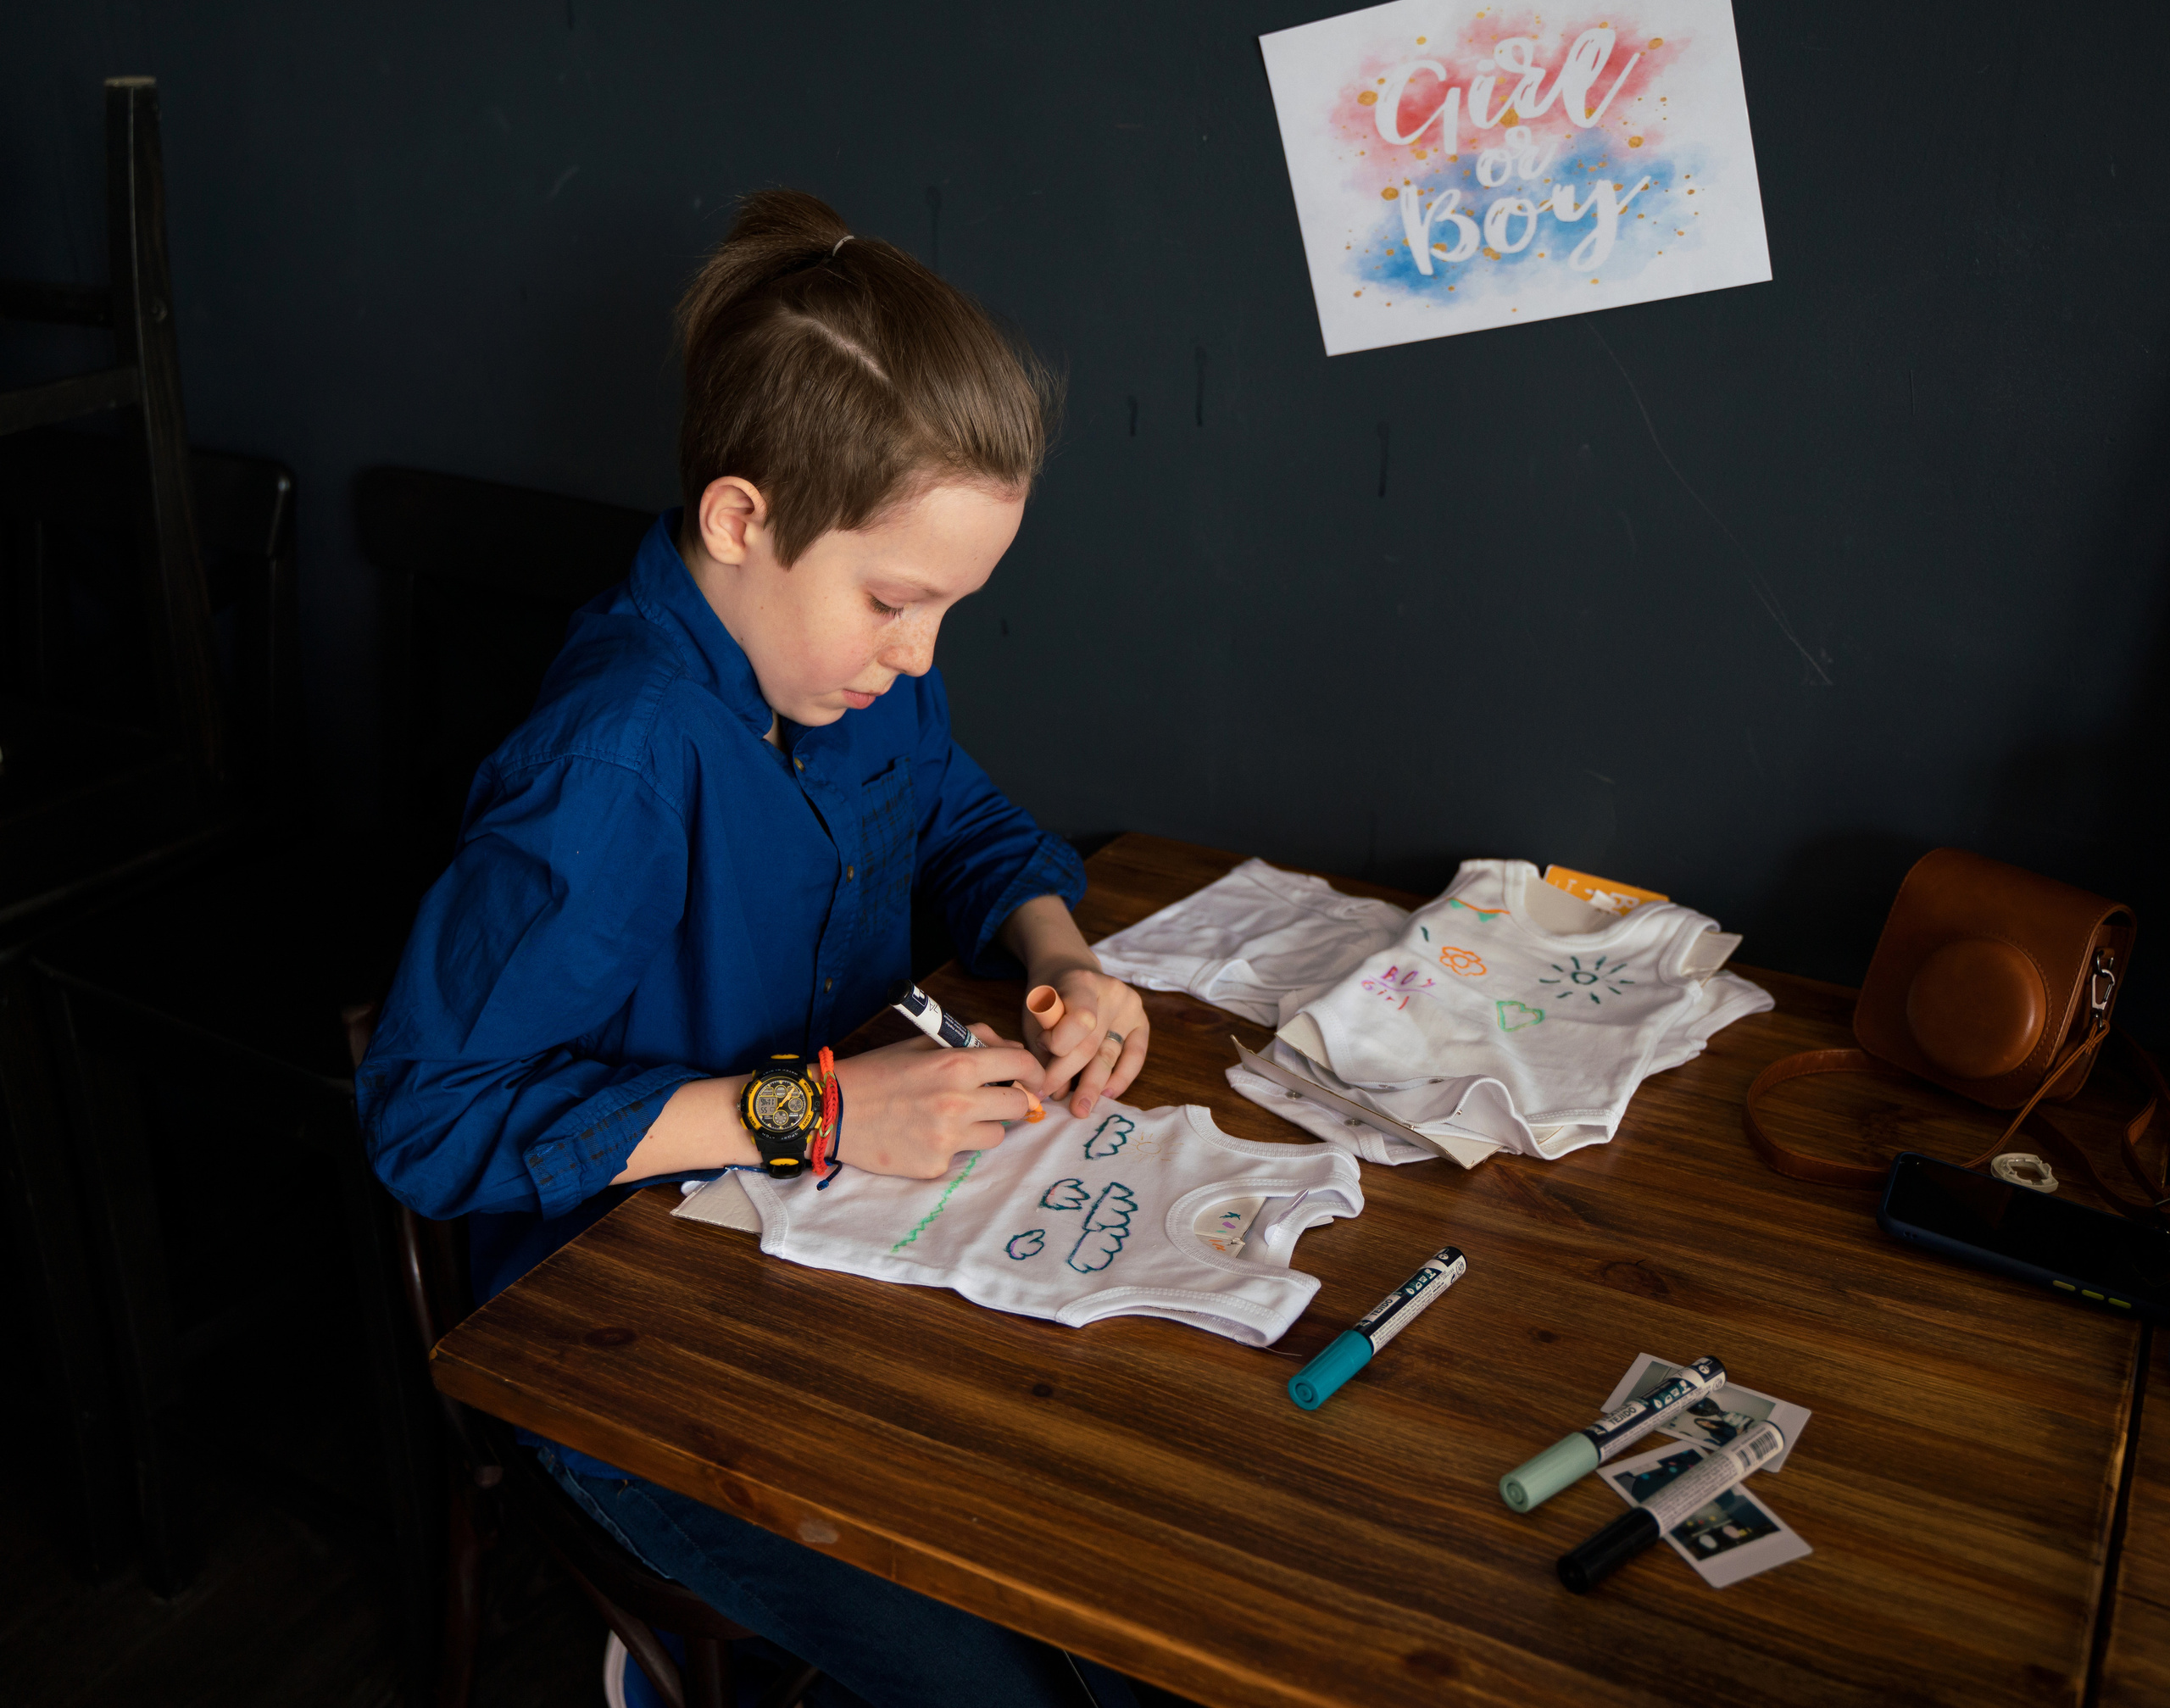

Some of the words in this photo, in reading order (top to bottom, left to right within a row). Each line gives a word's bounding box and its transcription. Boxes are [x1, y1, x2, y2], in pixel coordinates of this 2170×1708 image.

[1375, 28, 1641, 156] Girl
[1476, 125, 1558, 188] or
[1399, 175, 1652, 276] Boy
[1371, 1299, 1393, 1316] TEJIDO
[1608, 1406, 1637, 1426] TEJIDO
